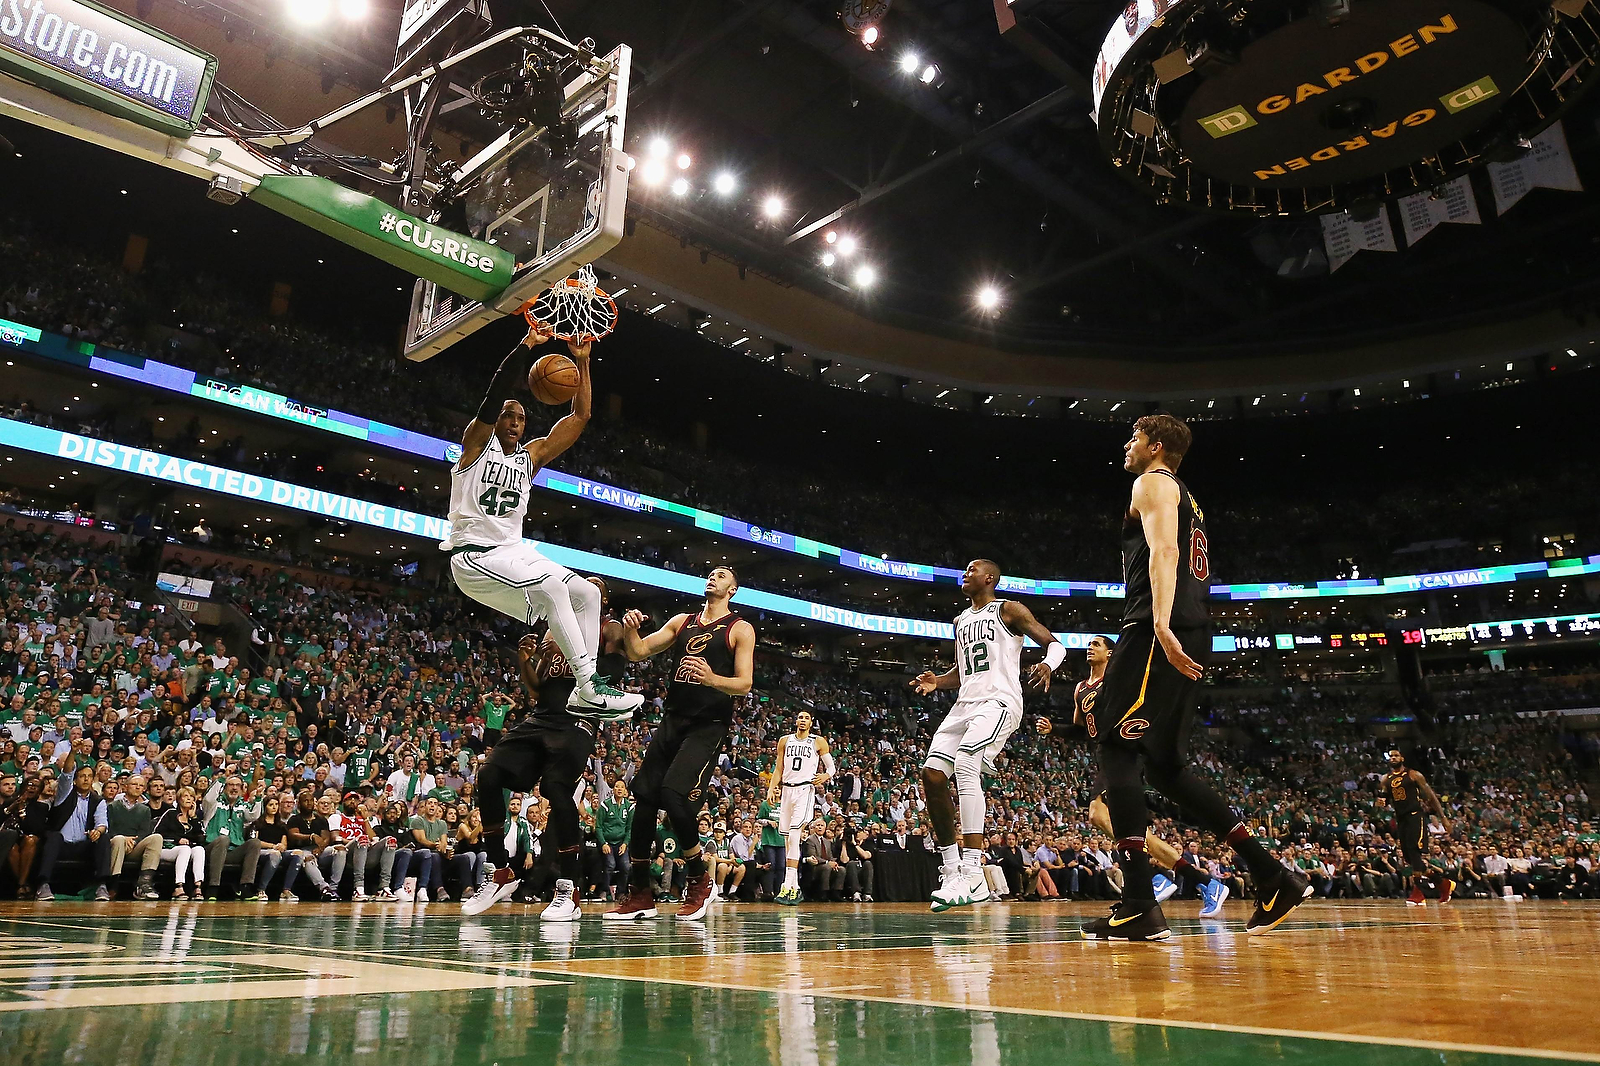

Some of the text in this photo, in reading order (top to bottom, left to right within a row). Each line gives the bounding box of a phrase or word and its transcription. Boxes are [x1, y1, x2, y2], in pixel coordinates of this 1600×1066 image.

[1256, 13, 1459, 116] GARDEN
[1253, 108, 1437, 181] GARDEN
[379, 212, 495, 274] #CUsRise
[206, 379, 322, 424] IT CAN WAIT
[58, 432, 263, 498] DISTRACTED
[271, 480, 386, 525] DRIVING
[392, 508, 416, 533] IS
[481, 460, 526, 494] CELTICS
[479, 486, 521, 517] 42
[578, 481, 655, 513] IT CAN WAIT
[762, 532, 782, 545] AT&T
[1189, 527, 1210, 581] 6
[859, 556, 920, 577] IT CAN WAIT
[1408, 570, 1492, 589] IT CAN WAIT
[1109, 584, 1126, 595] CA
[810, 602, 955, 640] DISTRACTED DRIV
[958, 619, 995, 650] CELTICS
[1295, 635, 1323, 645] Bank
[1402, 630, 1421, 644] 19
[964, 642, 990, 675] 12
[786, 744, 813, 759] CELTICS
[791, 757, 803, 772] 0
